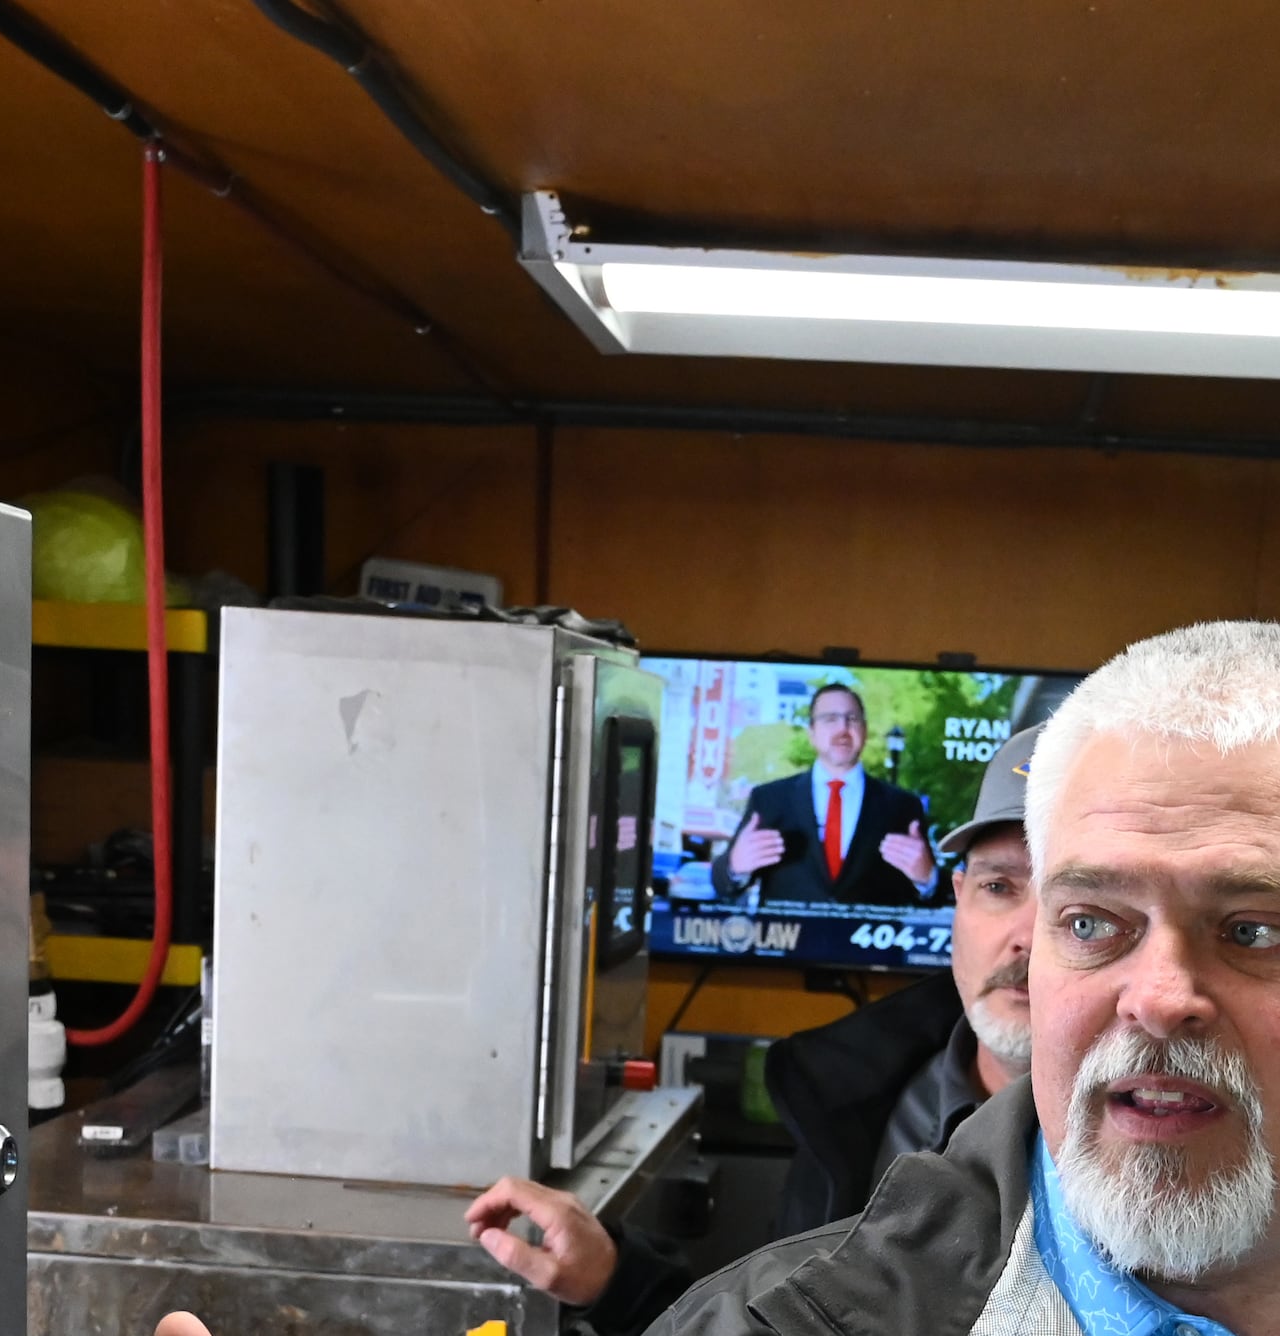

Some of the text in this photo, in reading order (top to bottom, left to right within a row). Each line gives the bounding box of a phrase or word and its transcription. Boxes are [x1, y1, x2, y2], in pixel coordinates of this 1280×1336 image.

[944, 716, 1011, 740] RYAN
[943, 740, 1003, 762] THO
[673, 916, 801, 950] LION LAW
[850, 923, 953, 953] 404-7
